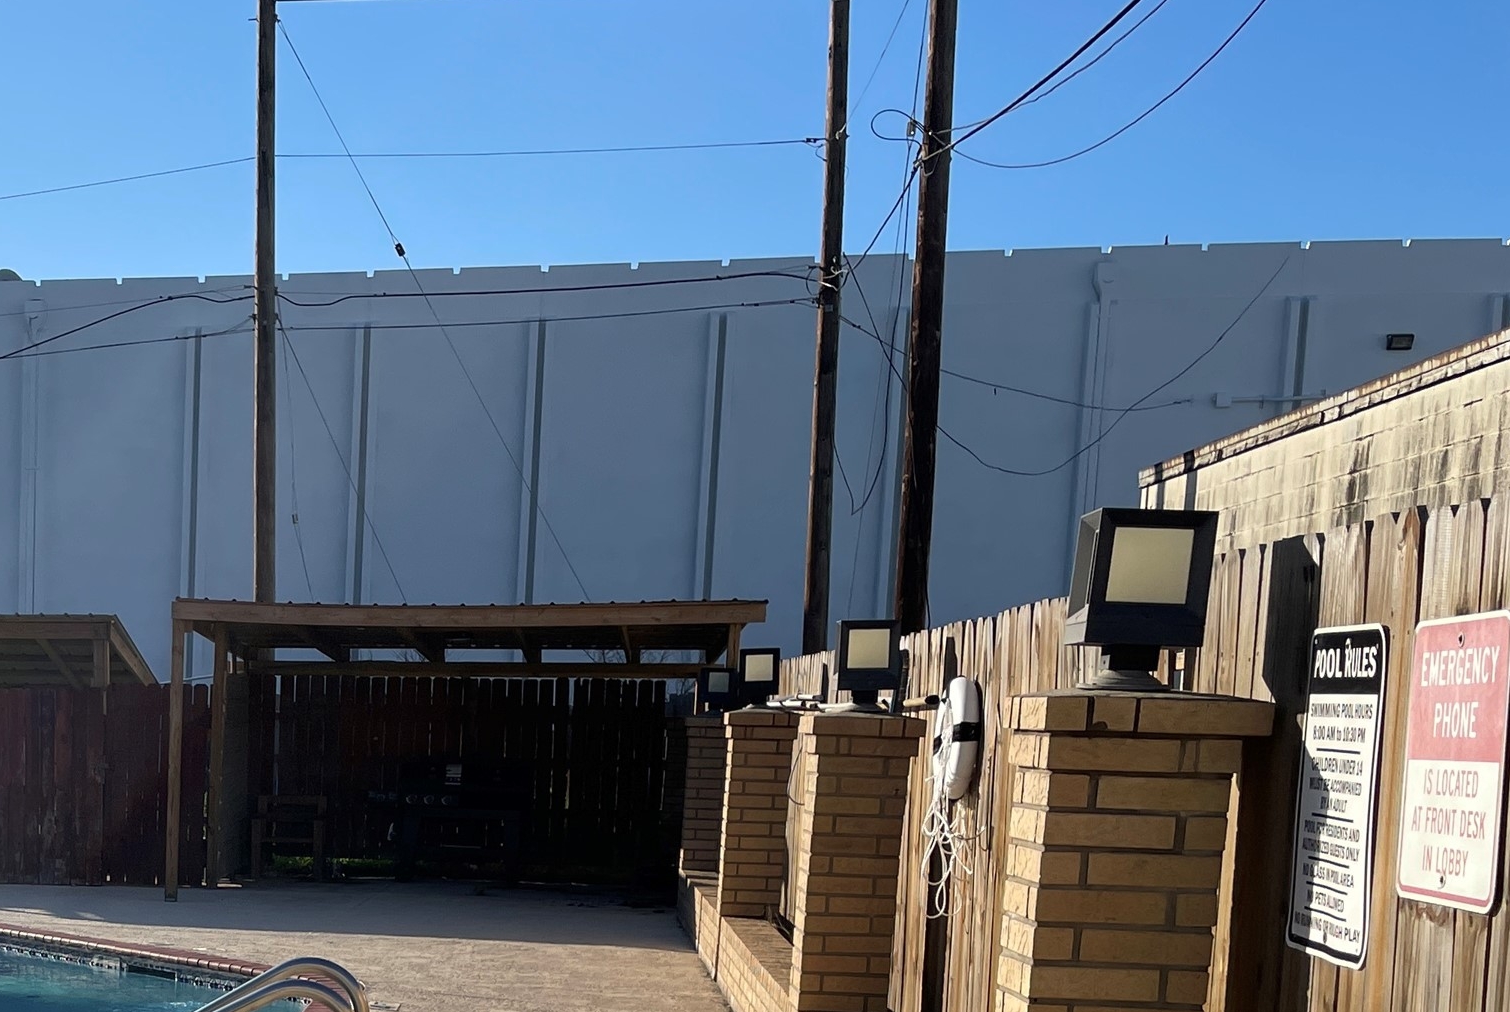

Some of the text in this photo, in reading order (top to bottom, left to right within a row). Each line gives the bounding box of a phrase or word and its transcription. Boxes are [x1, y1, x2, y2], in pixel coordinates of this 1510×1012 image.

[1314, 646, 1377, 678] POOL RULES
[1420, 646, 1500, 688] EMERGENCY
[1311, 703, 1373, 720] SWIMMING POOL HOURS
[1433, 701, 1479, 738] PHONE
[1313, 726, 1366, 742] 8:00 AM to 10:30 PM
[1312, 757, 1363, 776] CHILDREN UNDER 14
[1331, 780, 1361, 796] ACCOMPANIED
[1423, 769, 1479, 798] IS LOCATED
[1333, 799, 1347, 813] ADULT
[1412, 808, 1486, 840] AT FRONT DESK
[1349, 829, 1360, 842] AND
[1346, 846, 1360, 861] ONLY
[1422, 845, 1469, 878] IN LOBBY
[1340, 873, 1354, 888] AREA
[1315, 892, 1326, 907] PETS
[1344, 928, 1360, 943] PLAY
